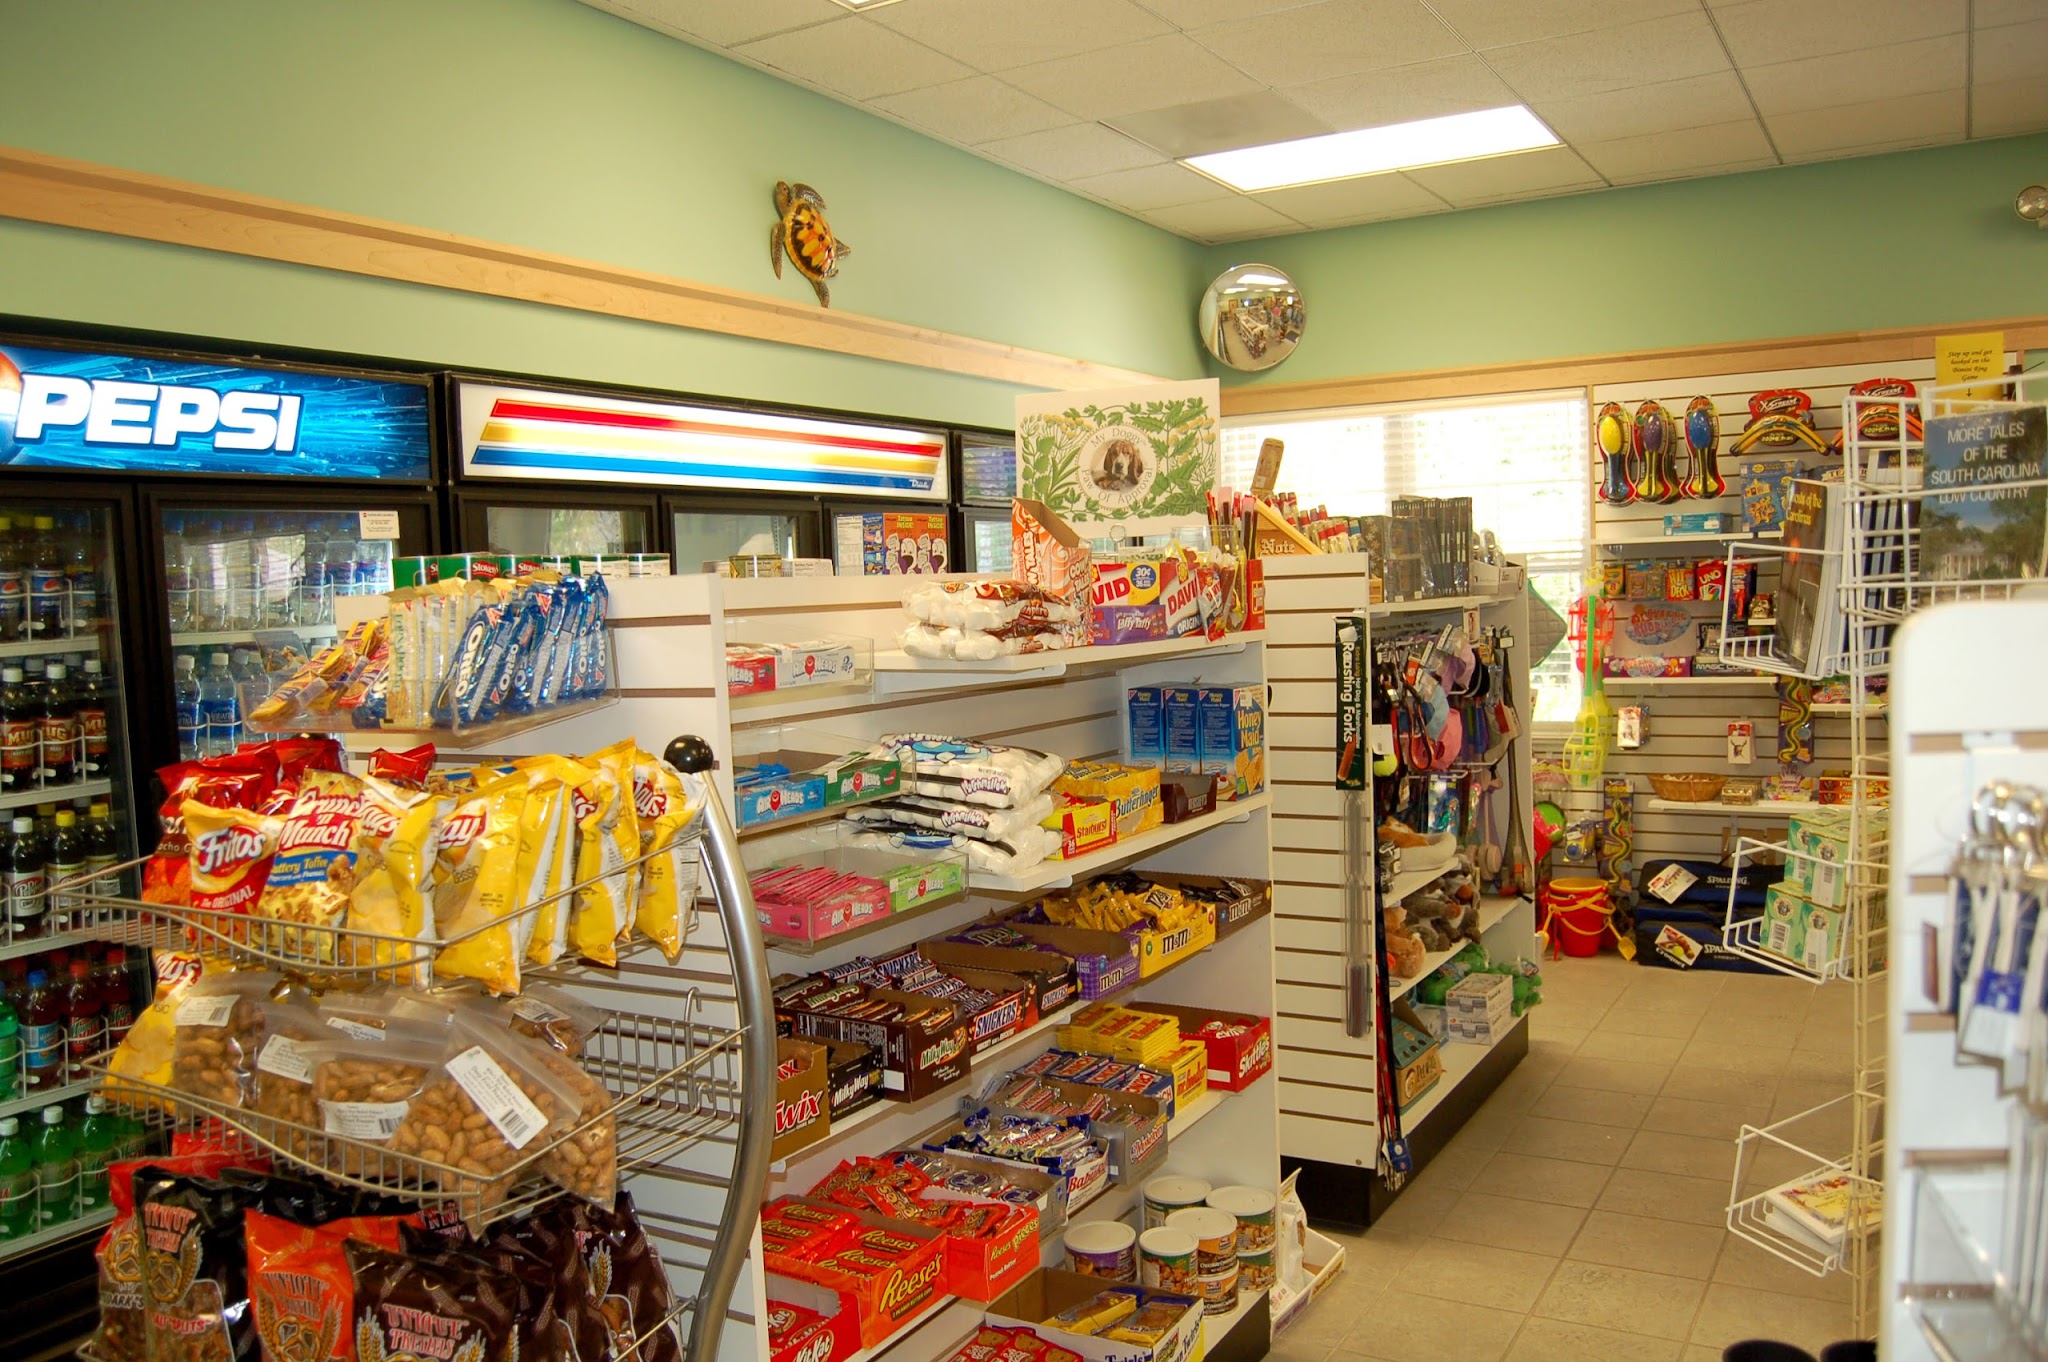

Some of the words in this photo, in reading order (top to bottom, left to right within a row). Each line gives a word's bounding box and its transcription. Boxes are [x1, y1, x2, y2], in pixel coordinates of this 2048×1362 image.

[14, 373, 304, 455] PEPSI
[1090, 433, 1106, 448] My
[1948, 428, 1985, 444] MORE
[1989, 423, 2025, 439] TALES
[1963, 447, 1980, 462] OF
[1984, 445, 2008, 460] THE
[1081, 469, 1096, 490] Paw
[1118, 466, 1154, 504] Approval
[1931, 469, 1974, 485] SOUTH
[1977, 462, 2041, 482] CAROLINA
[1939, 489, 1968, 504] LOW
[1970, 485, 2030, 502] COUNTRY
[1260, 538, 1295, 554] Note
[1699, 569, 1721, 584] UNO
[1092, 577, 1131, 606] VID
[1177, 615, 1201, 635] ORIGIN
[456, 622, 486, 698] OREO
[1340, 641, 1355, 703] Roasting
[1237, 710, 1262, 731] Honey
[1342, 706, 1356, 743] Forks
[41, 727, 67, 740] UG
[1241, 730, 1261, 748] Maid
[1115, 785, 1160, 818] Butterfinger
[281, 819, 350, 849] Munch
[1076, 820, 1108, 839] Starburst
[196, 826, 267, 874] Fritos
[212, 885, 256, 908] ORIGINAL
[975, 1000, 1018, 1037] SNICKERS
[1239, 1036, 1270, 1079] Skittles
[879, 1253, 944, 1314] Reese's
